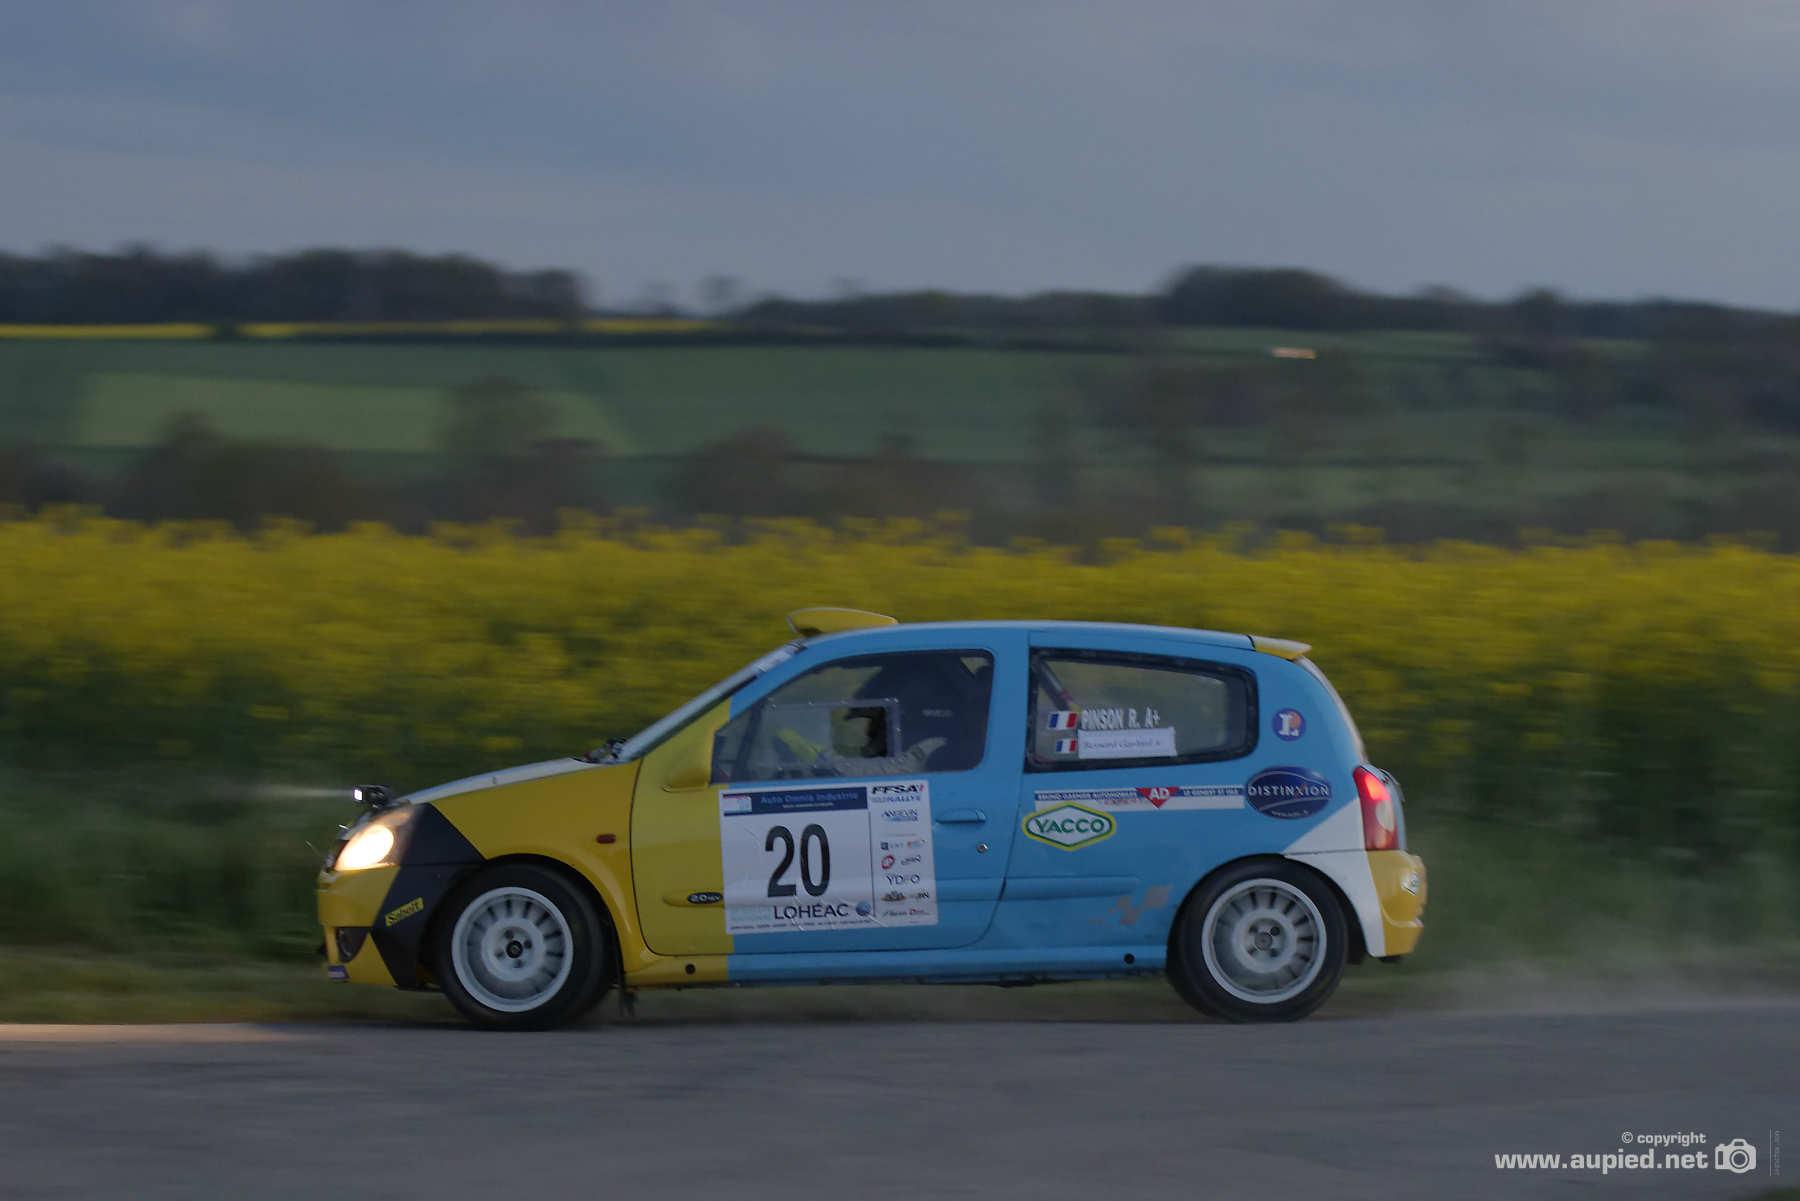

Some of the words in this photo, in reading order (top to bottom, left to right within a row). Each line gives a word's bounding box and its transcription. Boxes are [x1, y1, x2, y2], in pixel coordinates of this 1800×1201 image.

[1149, 788, 1170, 800] AD
[1247, 784, 1330, 797] DISTINXION
[1036, 817, 1105, 833] YACCO
[764, 823, 831, 899] 20
[774, 903, 849, 920] LOHÉAC
